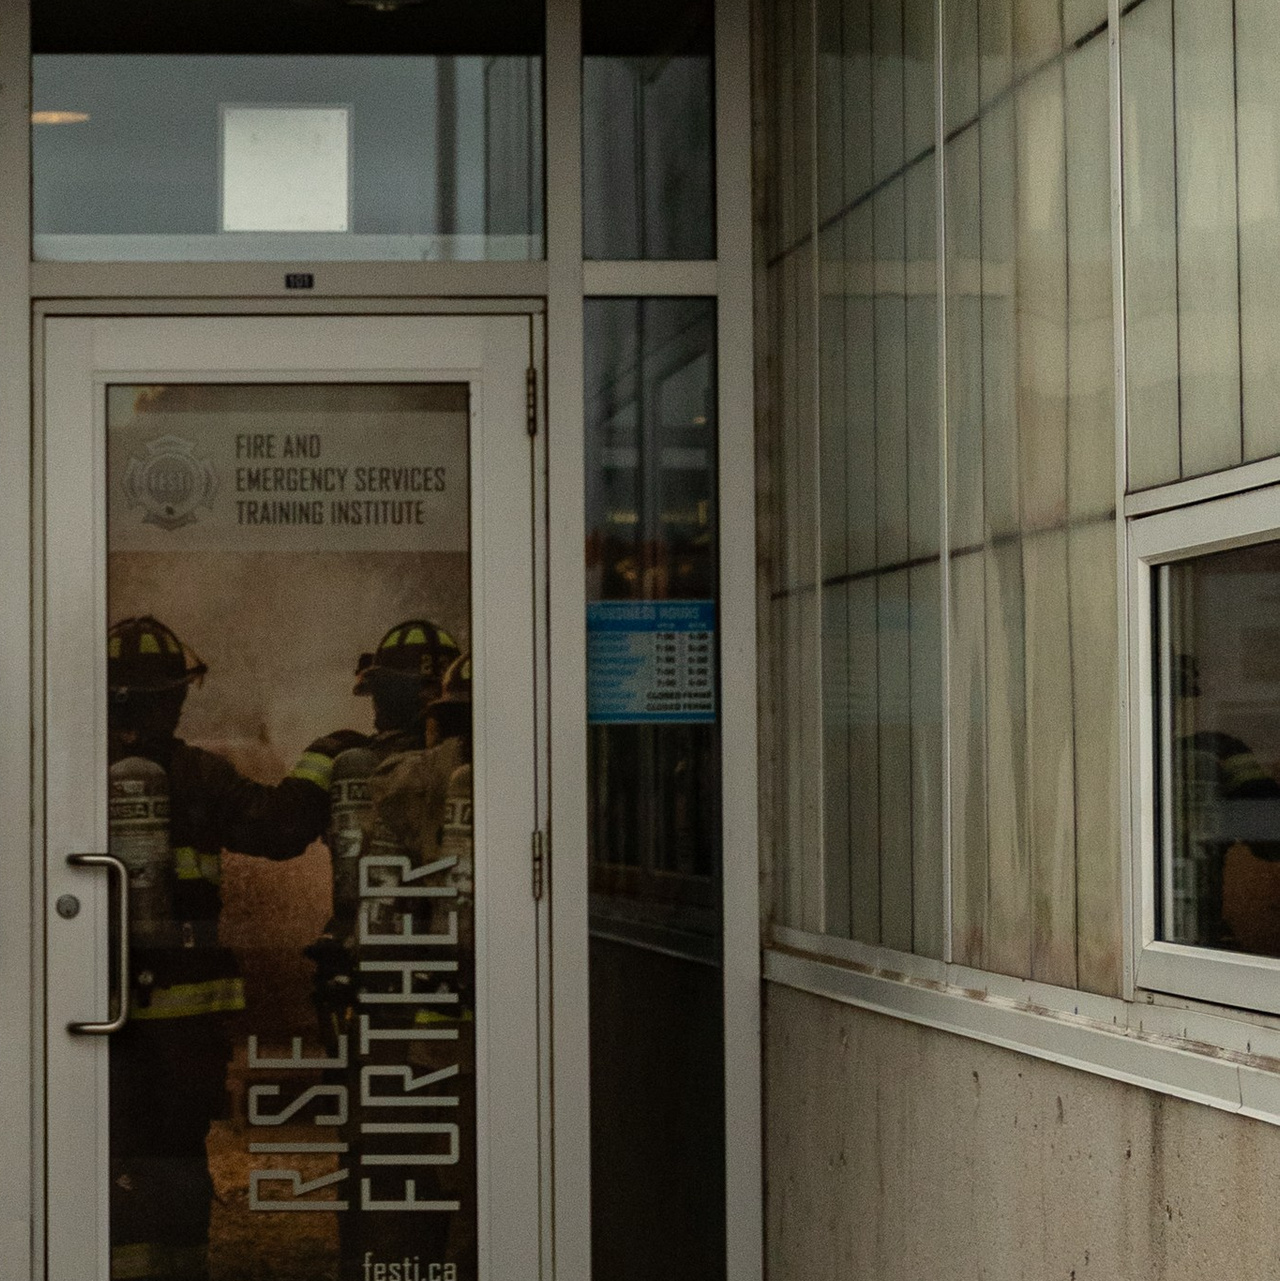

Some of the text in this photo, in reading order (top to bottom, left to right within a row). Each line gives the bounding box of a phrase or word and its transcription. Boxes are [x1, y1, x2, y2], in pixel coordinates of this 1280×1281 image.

[235, 434, 320, 459] FIRE AND
[235, 467, 446, 492] EMERGENCY SERVICES
[236, 500, 424, 525] TRAINING INSTITUTE
[358, 855, 460, 1211] FURTHER
[248, 1034, 349, 1211] RISE
